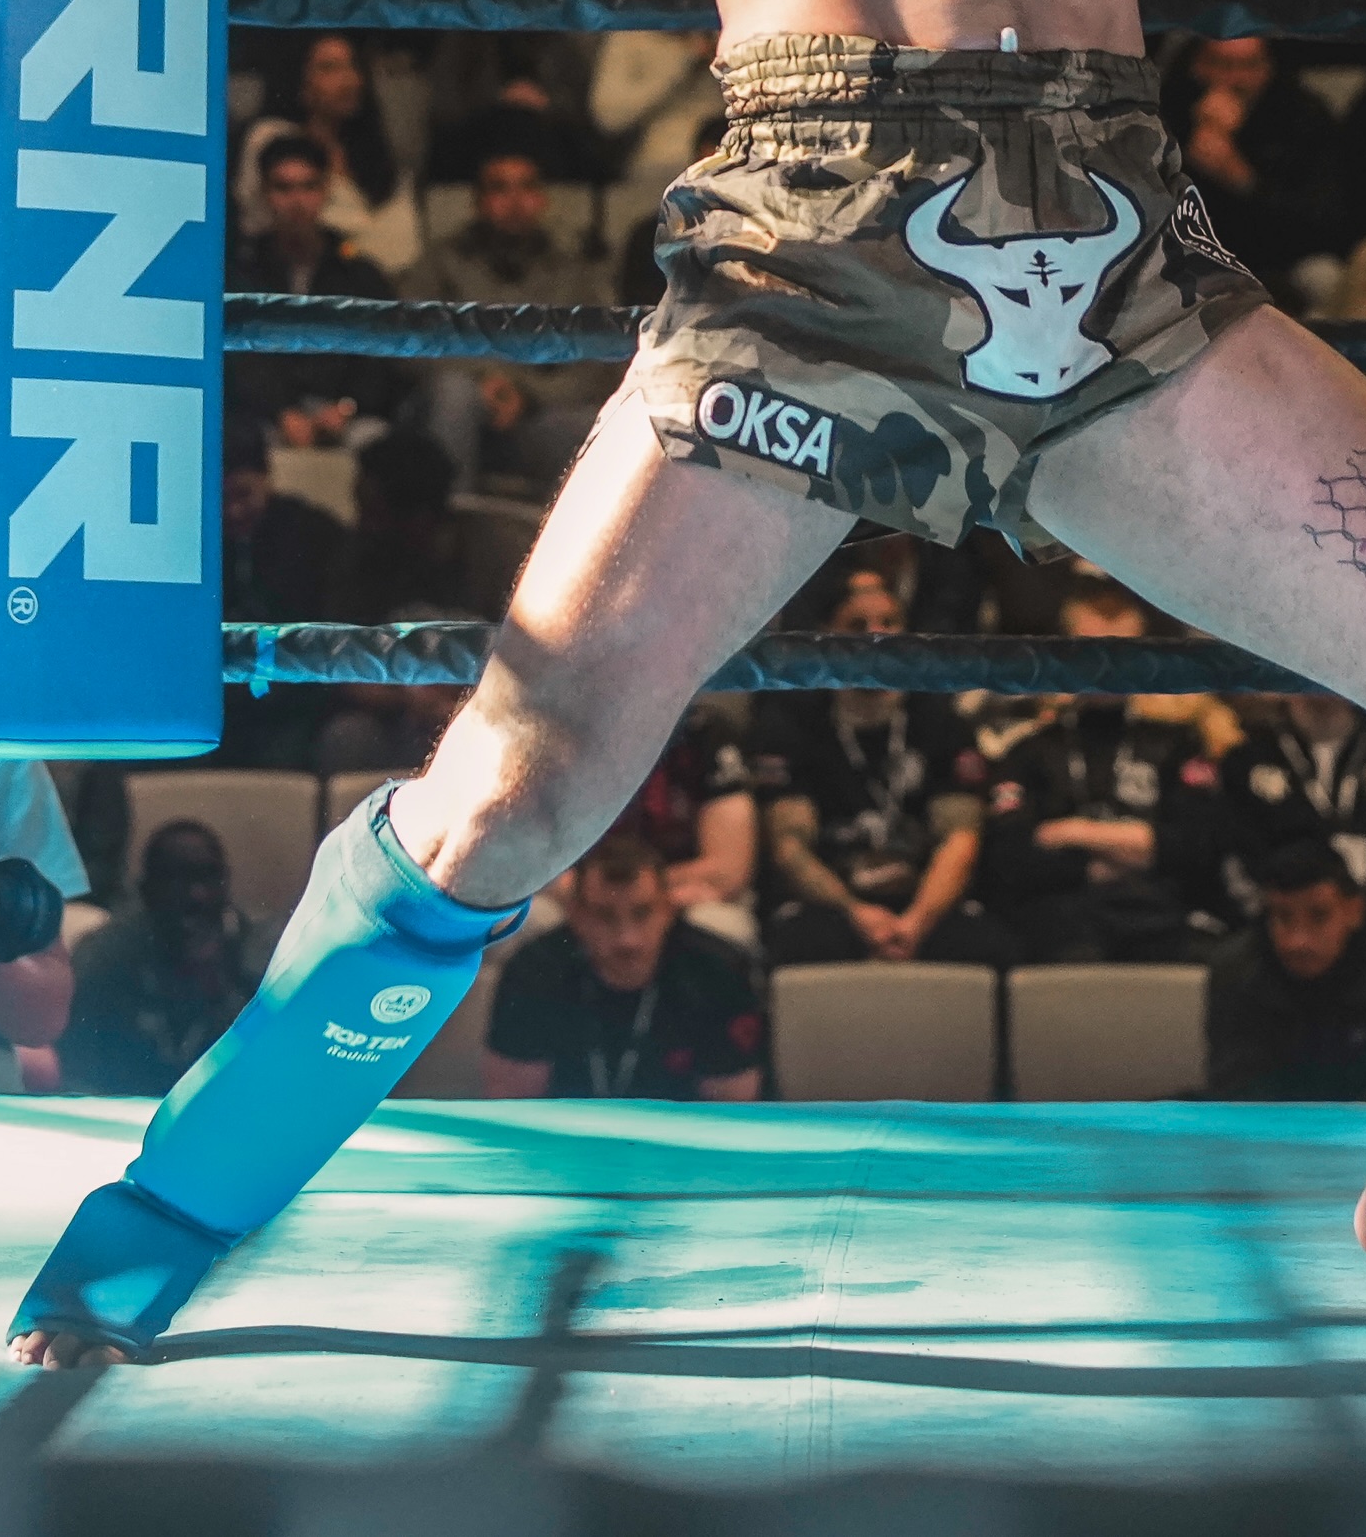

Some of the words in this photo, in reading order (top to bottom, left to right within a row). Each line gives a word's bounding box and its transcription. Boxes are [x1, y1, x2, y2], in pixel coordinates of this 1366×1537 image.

[699, 381, 833, 476] OKSA
[322, 1019, 369, 1047] TOP
[366, 1034, 412, 1050] TEN
